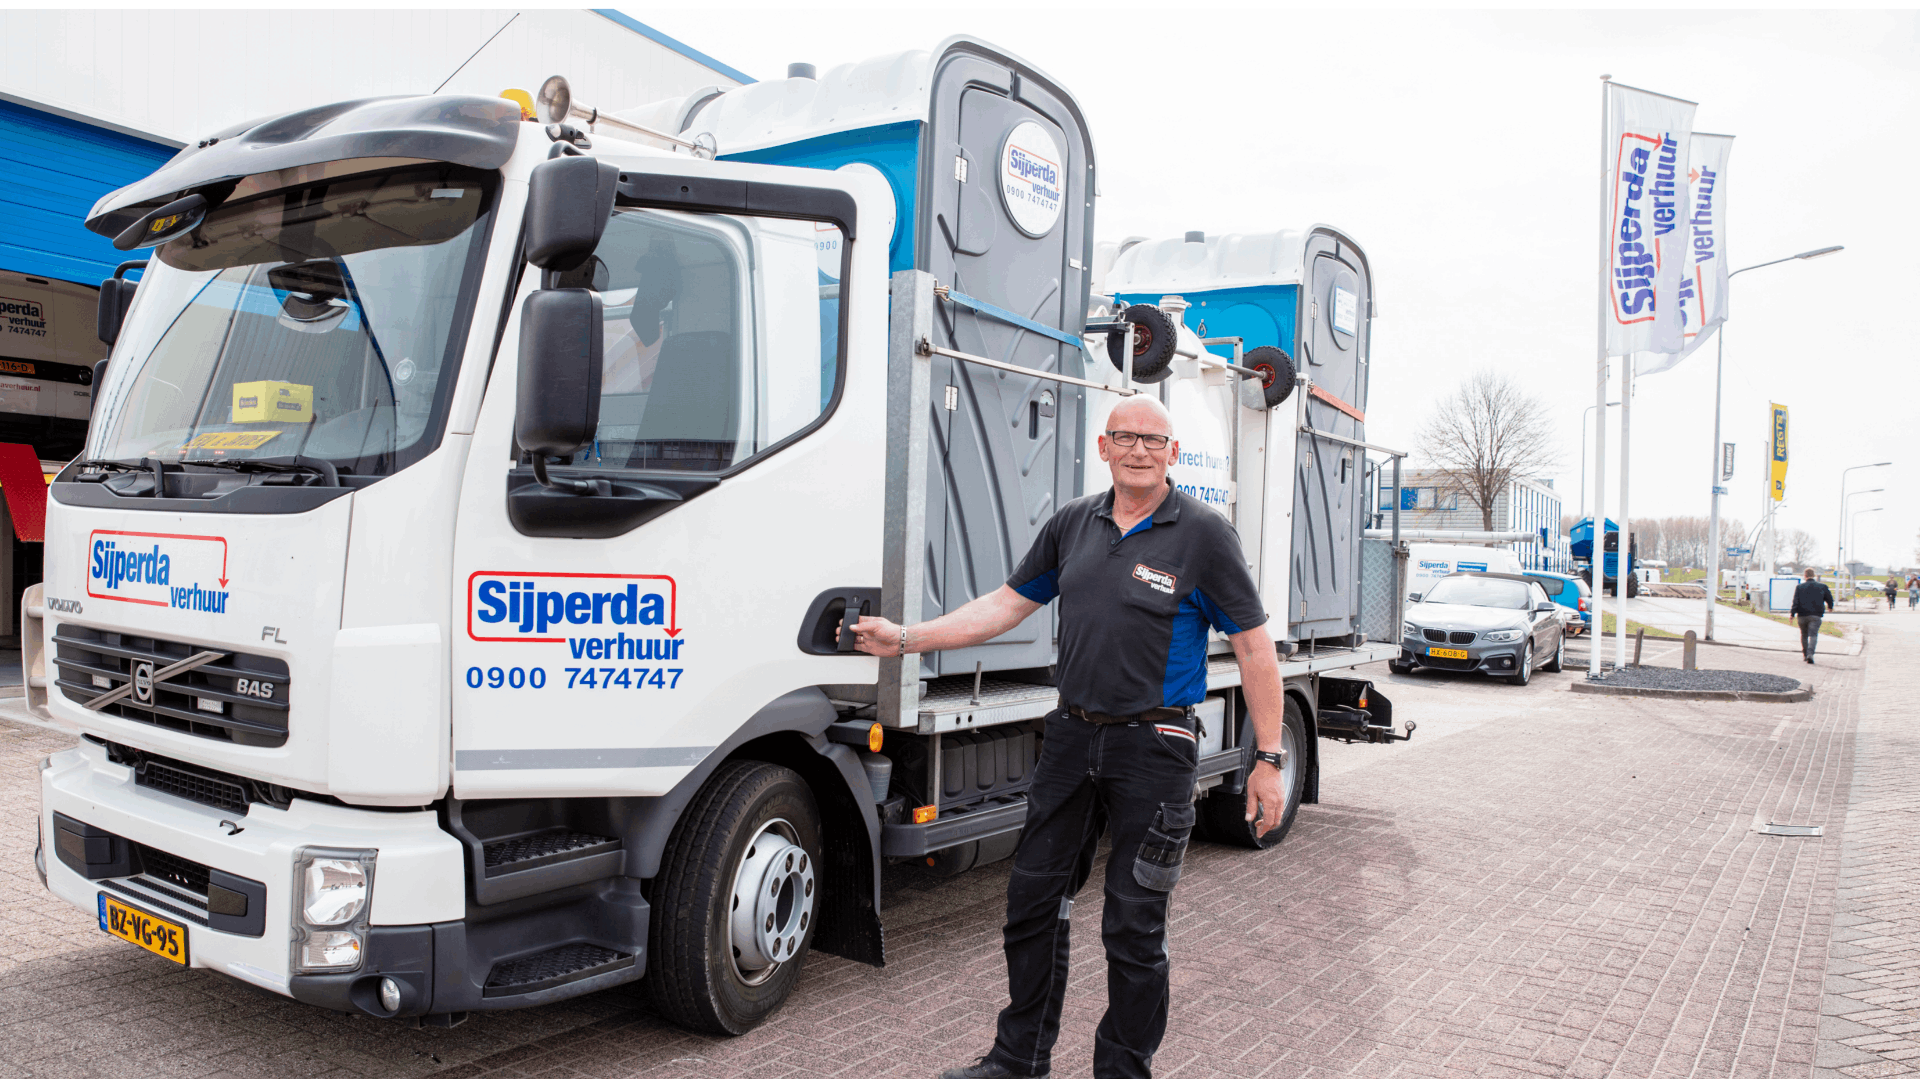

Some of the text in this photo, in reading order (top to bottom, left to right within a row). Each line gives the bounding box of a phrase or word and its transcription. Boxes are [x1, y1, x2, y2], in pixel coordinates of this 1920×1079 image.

[1010, 149, 1056, 185] Sijperda
[1032, 182, 1060, 202] verhuur
[1649, 132, 1677, 236] verhuur
[1006, 184, 1057, 212] 0900 7474747
[1690, 165, 1716, 263] verhuur
[1615, 147, 1655, 315] Sijperda
[8, 325, 46, 337] 7474747
[9, 316, 46, 329] verhuur
[1178, 447, 1203, 468] irect
[92, 540, 170, 589] Sijperda
[1419, 561, 1449, 570] Sijperda
[1135, 566, 1173, 587] Sijperda
[1150, 582, 1175, 594] verhuur
[46, 596, 84, 615] VOLVO
[170, 582, 229, 614] verhuur
[477, 580, 665, 634] Sijperda
[261, 625, 287, 645] FL
[568, 632, 685, 660] verhuur
[236, 678, 274, 699] BAS
[466, 666, 684, 689] 0900 7474747
[109, 904, 179, 956] BZ-VG-95
